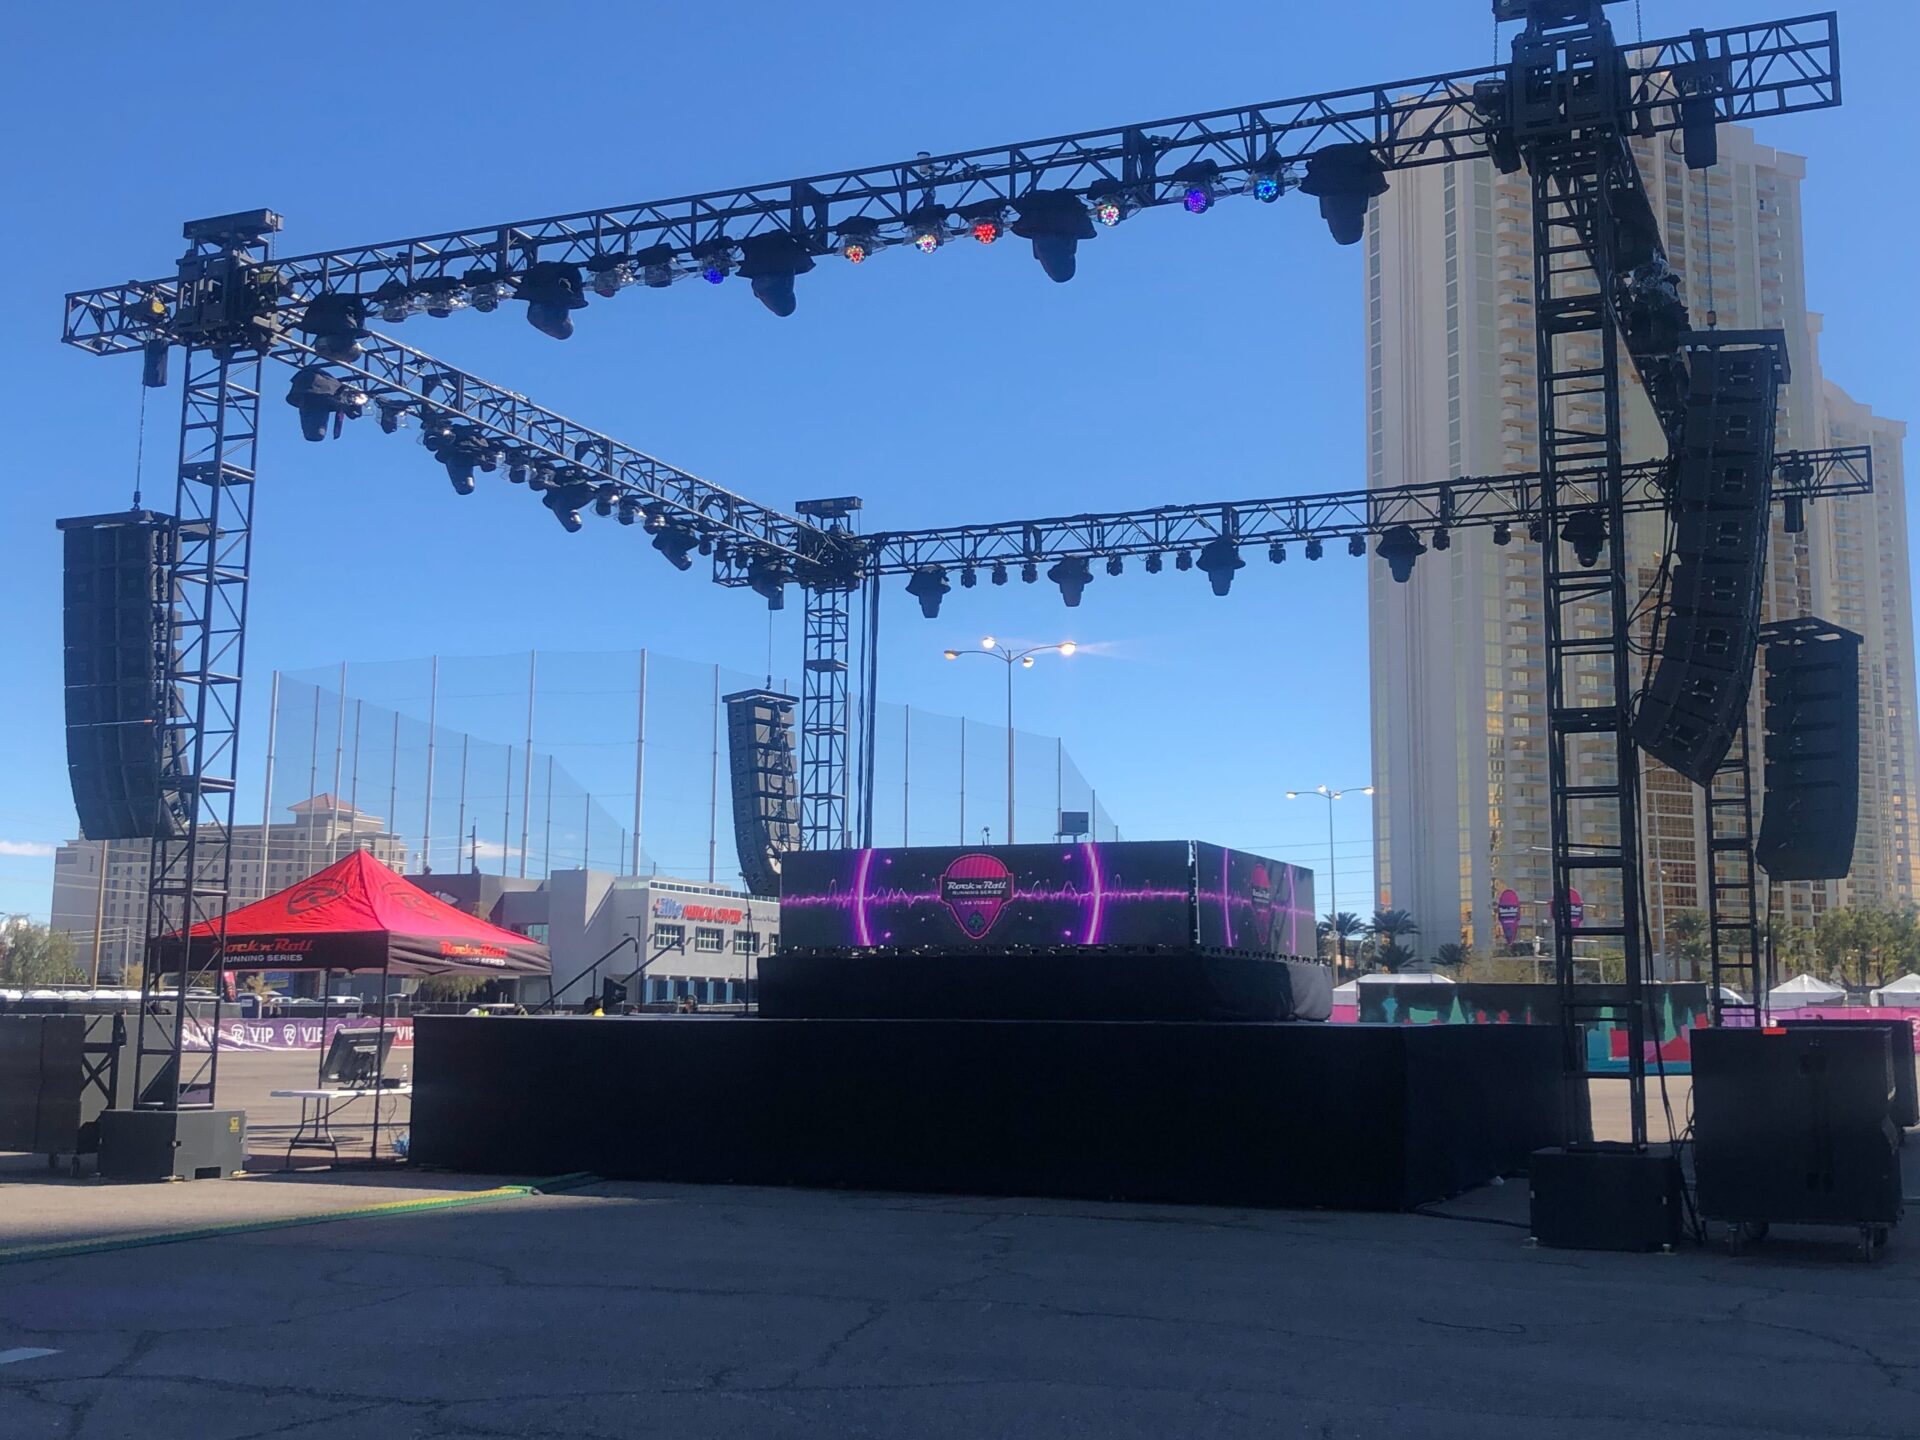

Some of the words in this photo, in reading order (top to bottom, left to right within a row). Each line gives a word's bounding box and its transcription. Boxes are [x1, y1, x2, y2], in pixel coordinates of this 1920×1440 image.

[946, 881, 975, 890] Rock
[983, 880, 1007, 889] Roll
[266, 954, 303, 962] SERIES
[249, 1026, 274, 1043] VIP
